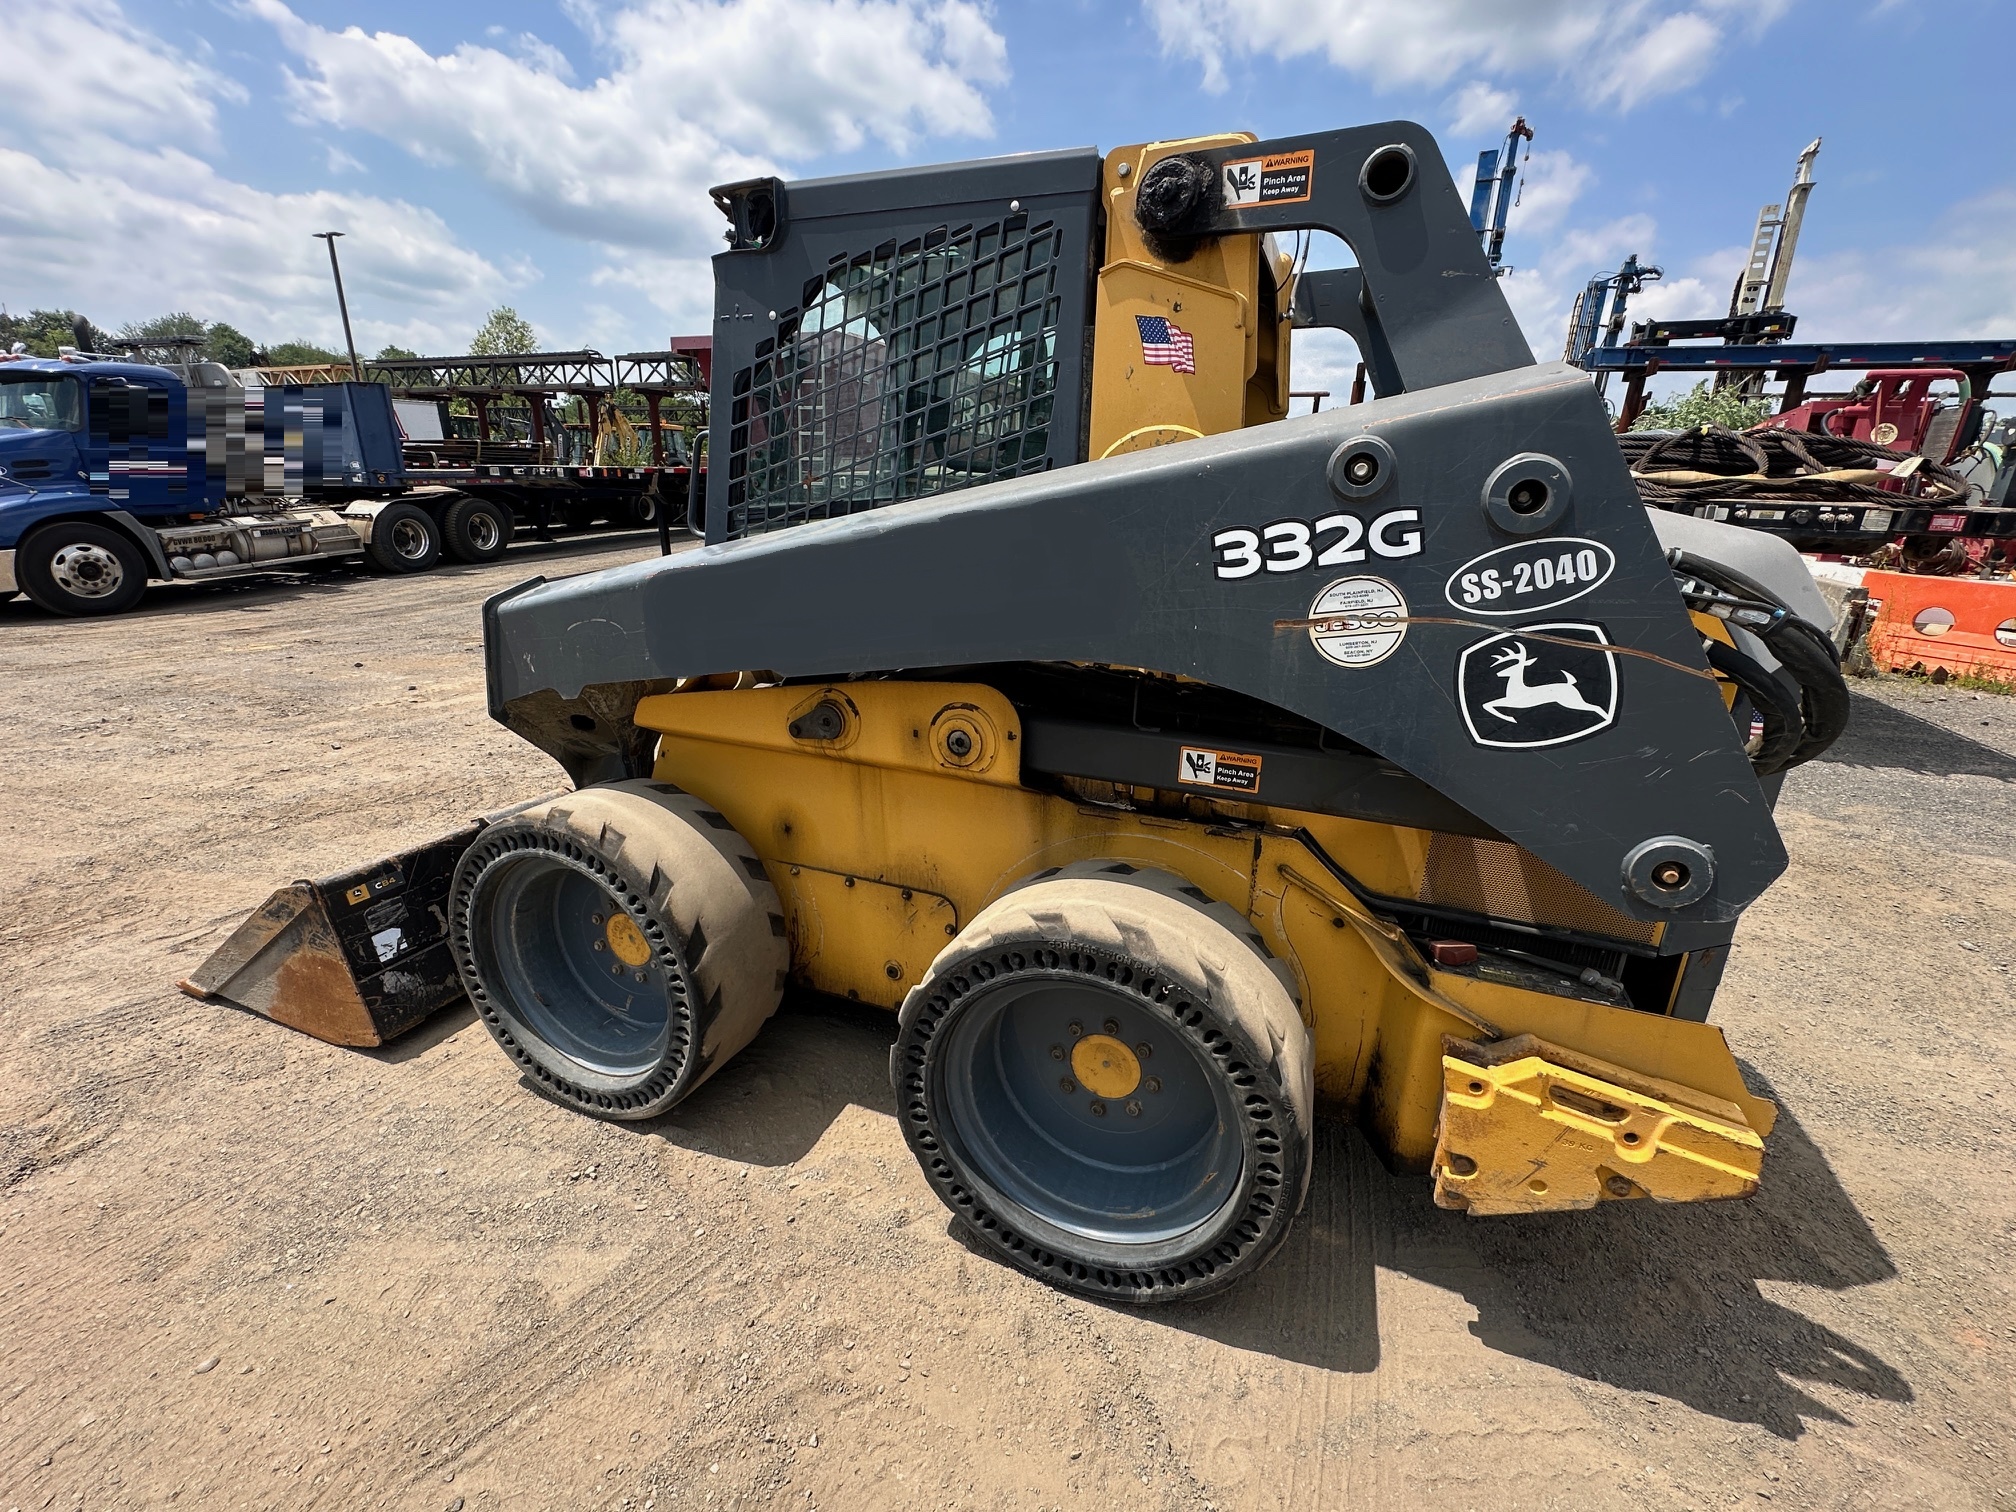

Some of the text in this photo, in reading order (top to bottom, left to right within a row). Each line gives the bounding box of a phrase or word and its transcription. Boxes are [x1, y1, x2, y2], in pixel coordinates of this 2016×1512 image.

[1273, 155, 1308, 166] WARNING
[1263, 174, 1306, 186] Pinch Area
[1262, 186, 1300, 196] Keep Away
[1213, 508, 1422, 579] 332G
[1461, 549, 1598, 604] SS-2040
[1226, 755, 1257, 764] WARNING
[1217, 767, 1254, 778] Pinch Area
[1216, 775, 1249, 786] Keep Away
[1048, 939, 1157, 977] CONSTRUCTION PRO
[1577, 1141, 1595, 1153] KG
